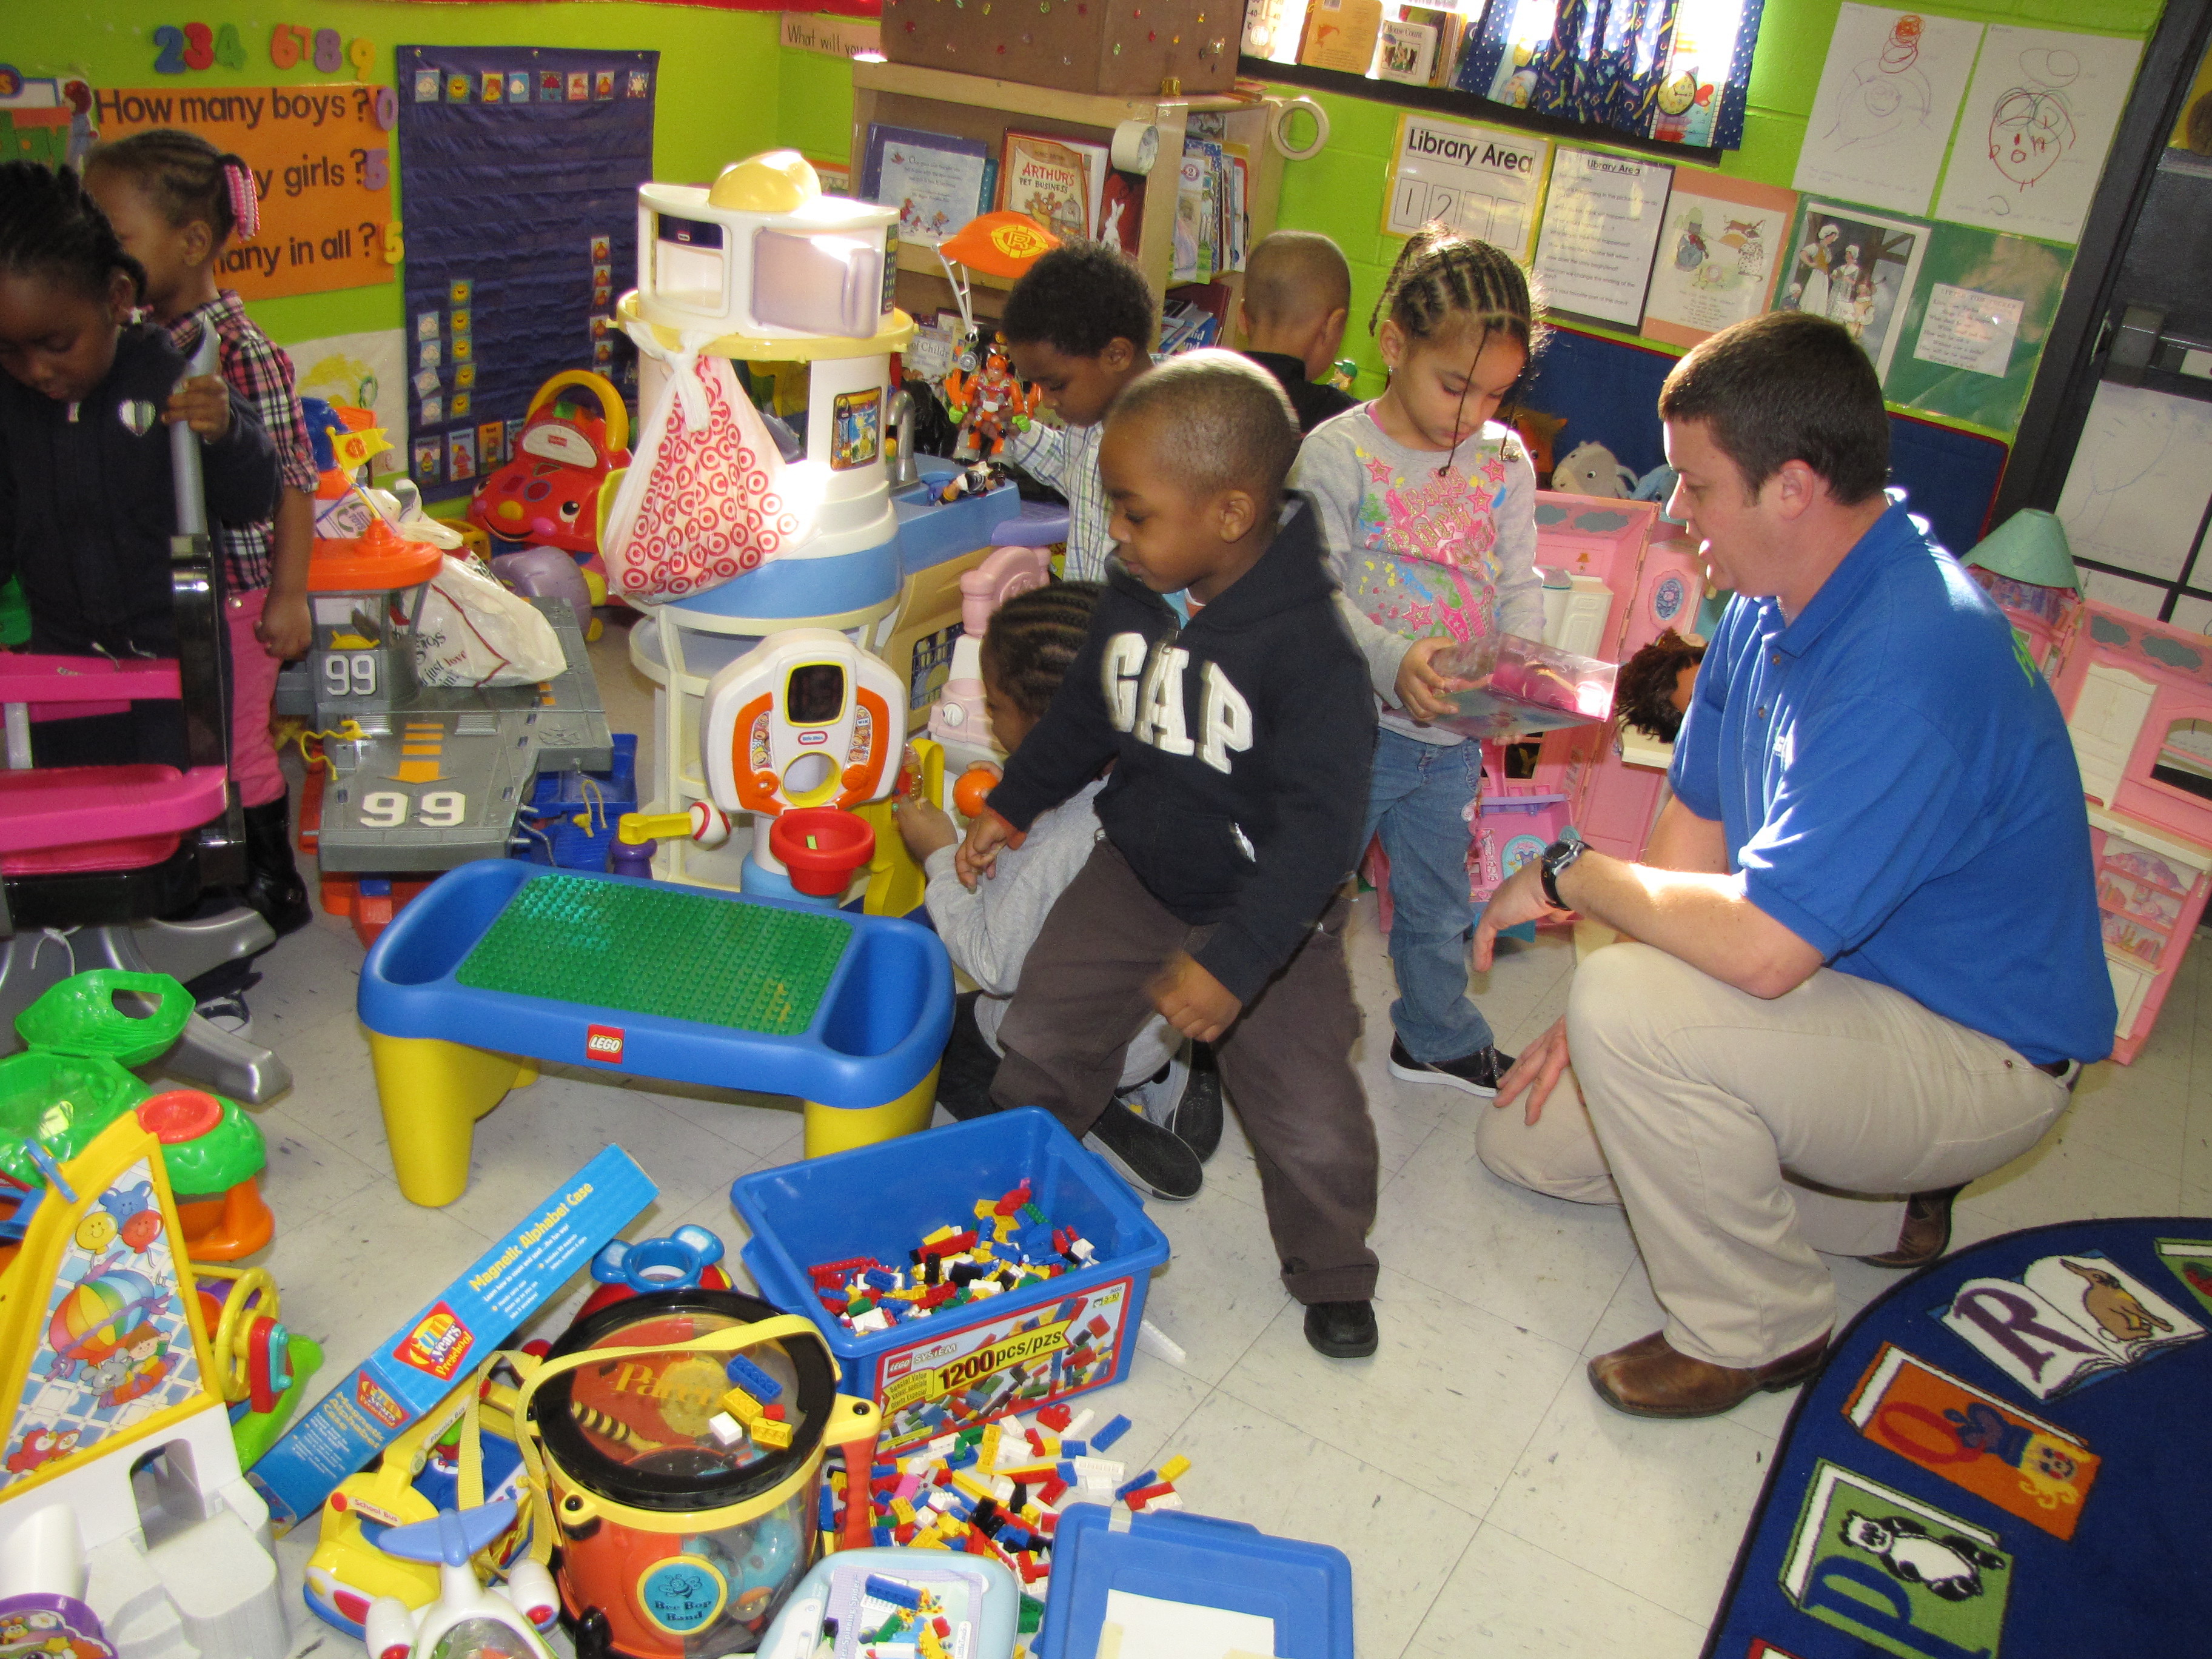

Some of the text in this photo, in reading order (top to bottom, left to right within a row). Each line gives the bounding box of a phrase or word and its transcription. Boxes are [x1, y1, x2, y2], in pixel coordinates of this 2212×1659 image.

[788, 24, 862, 57] What will you
[1405, 27, 1422, 38] Count
[96, 89, 172, 123] How
[180, 95, 264, 129] many
[272, 88, 345, 126] boys
[1408, 129, 1533, 173] Library Area
[1587, 159, 1641, 176] Library Area
[284, 155, 344, 197] girls
[364, 149, 389, 191] 5
[1022, 163, 1074, 187] ARTHUR'S
[1035, 181, 1068, 193] BUSINESS
[1187, 167, 1193, 176] 2
[1433, 194, 1452, 221] 2
[290, 237, 314, 266] in
[321, 229, 350, 259] all
[384, 221, 404, 264] 5
[911, 340, 919, 350] of
[326, 655, 377, 695] 99
[424, 659, 444, 684] just
[443, 649, 467, 667] love
[1101, 632, 1253, 775] GAP
[360, 791, 467, 827] 99
[591, 1036, 621, 1052] LEGO
[469, 1183, 594, 1292] Magnetic Alphabet Case
[483, 1287, 498, 1302] Learn
[495, 1278, 508, 1290] how
[511, 1264, 525, 1277] count
[521, 1255, 533, 1267] and
[551, 1231, 561, 1241] fun
[435, 1331, 473, 1376] Preschool
[1952, 1287, 2109, 1384] R
[890, 1344, 957, 1372] LEGO SYSTEM
[939, 1350, 995, 1390] 1200
[613, 1362, 726, 1408] Paren
[890, 1372, 927, 1392] Special Value
[323, 1403, 347, 1430] Case
[329, 1398, 380, 1449] Alphabet
[336, 1391, 384, 1441] Magnetic
[431, 1406, 465, 1444] Phonics Bus
[354, 1498, 398, 1523] School Bus
[655, 1600, 712, 1610] Bee Bop
[667, 1611, 703, 1621] Band
